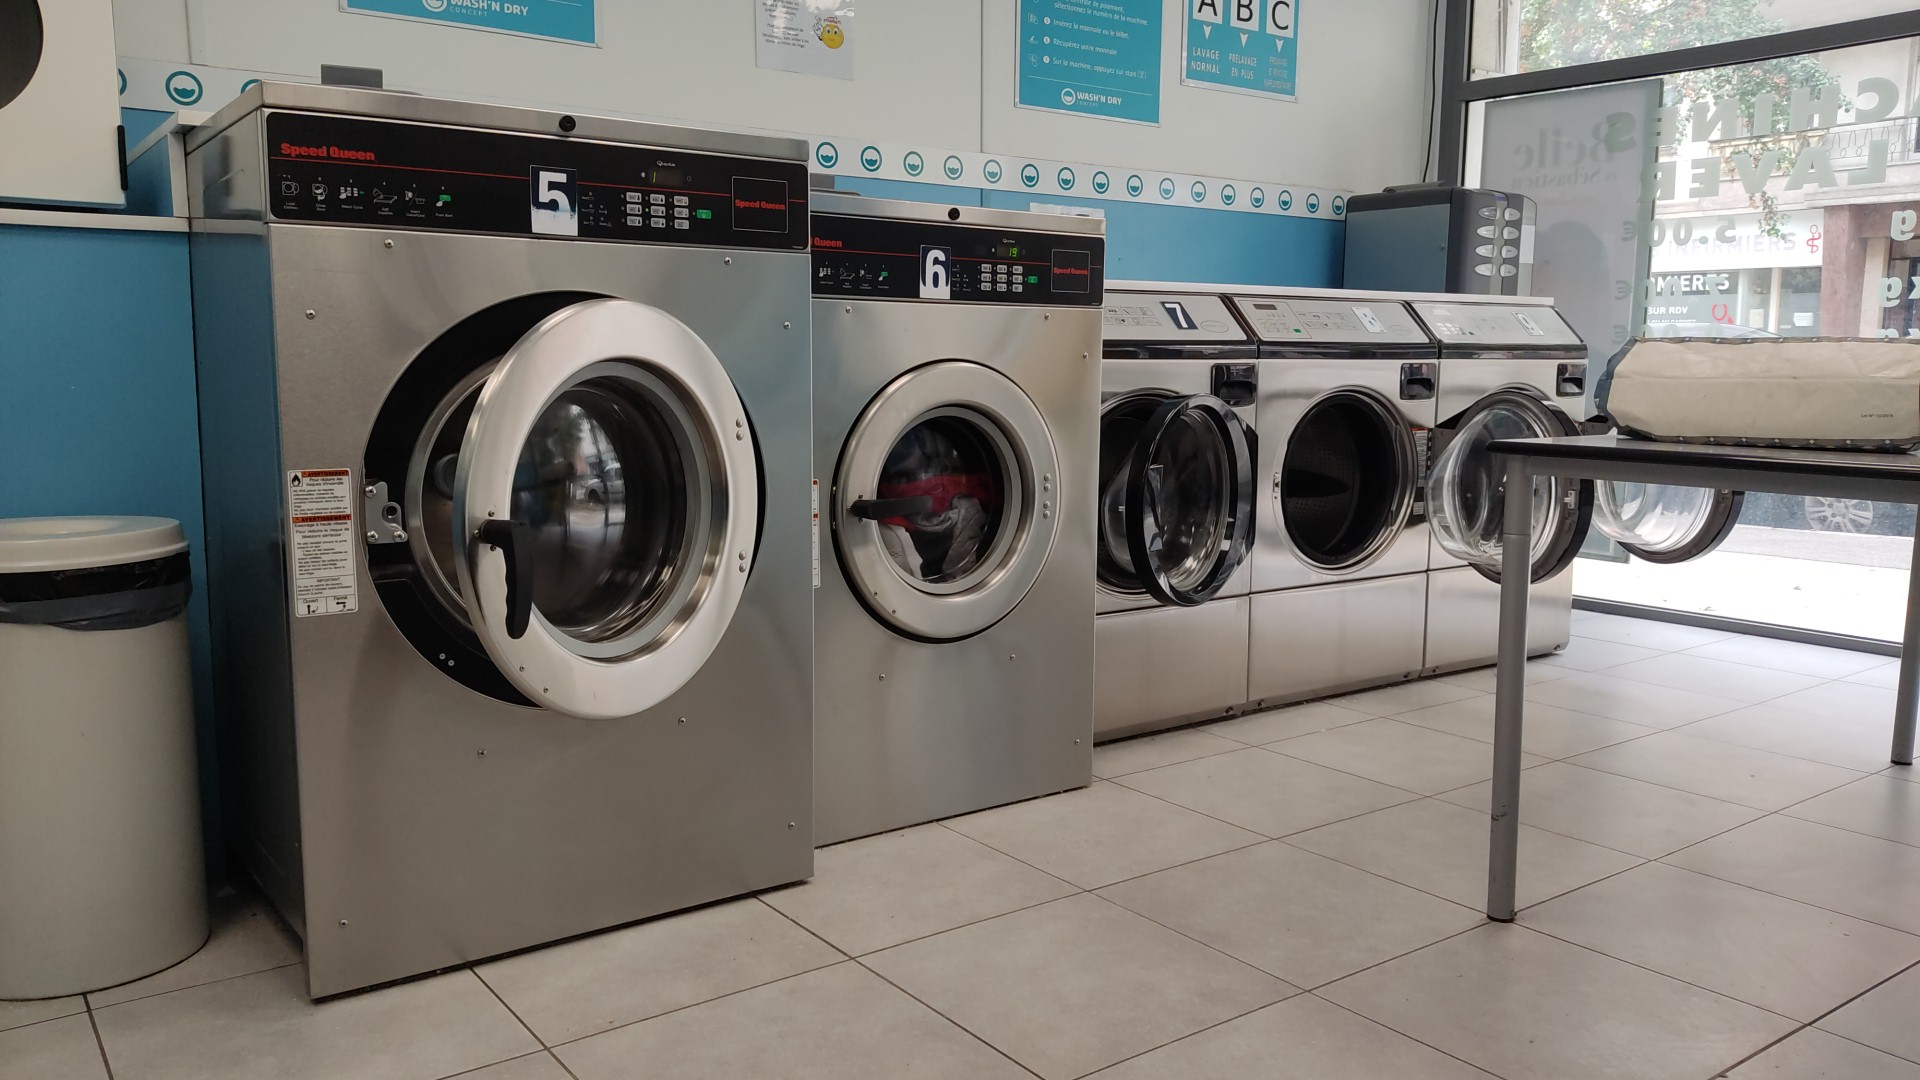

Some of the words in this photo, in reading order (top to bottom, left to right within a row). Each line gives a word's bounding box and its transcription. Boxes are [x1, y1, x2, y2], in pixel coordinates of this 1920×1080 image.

[449, 6, 488, 17] CONCEPT
[504, 3, 529, 16] DRY
[1197, 0, 1218, 17] A
[1237, 0, 1253, 22] B
[1271, 0, 1290, 30] C
[1192, 46, 1220, 60] LAVAGE
[1190, 60, 1221, 74] NORMAL
[1241, 69, 1254, 80] PLUS
[1077, 91, 1106, 103] WASH'N
[1107, 96, 1122, 106] DRY
[281, 143, 327, 157] Speed
[330, 146, 375, 161] Queen
[538, 170, 577, 220] 5
[735, 199, 760, 209] Speed
[760, 201, 785, 211] Queen
[814, 237, 843, 248] Queen
[1009, 247, 1019, 257] 19
[924, 249, 949, 292] 6
[1163, 303, 1189, 329] 7
[1668, 305, 1688, 315] RDV
